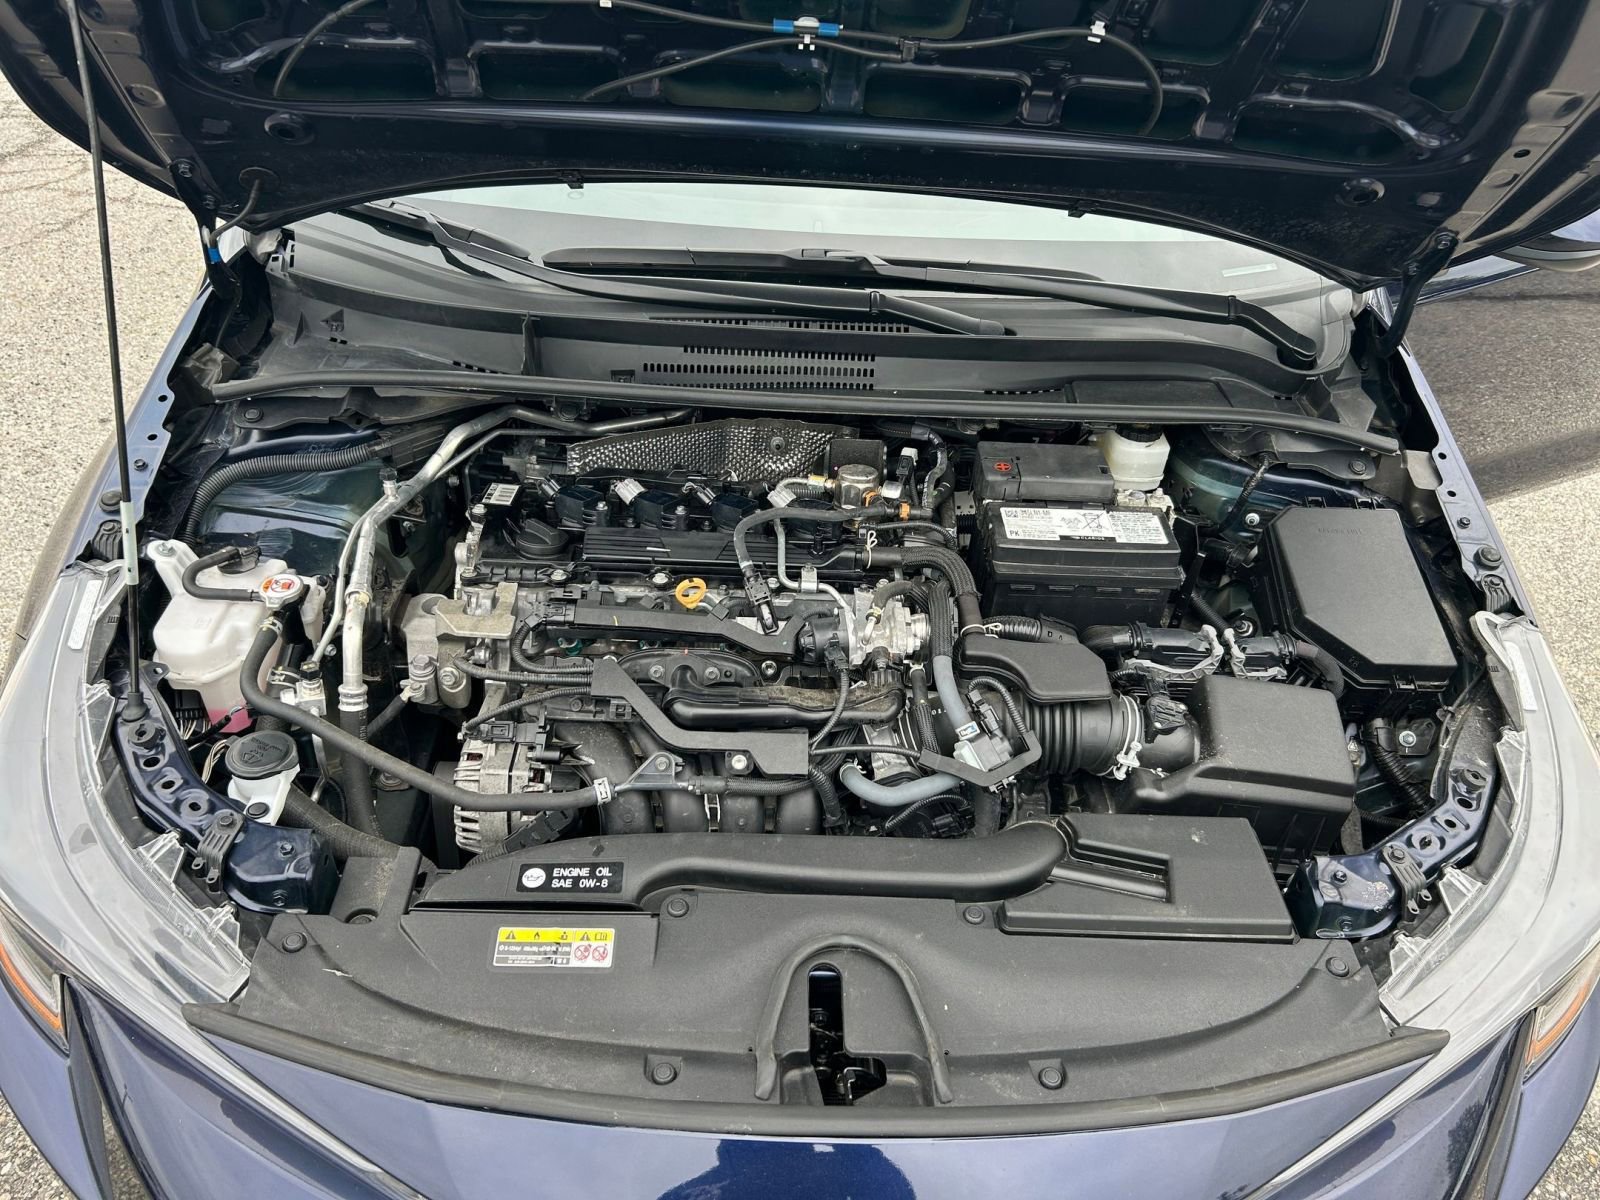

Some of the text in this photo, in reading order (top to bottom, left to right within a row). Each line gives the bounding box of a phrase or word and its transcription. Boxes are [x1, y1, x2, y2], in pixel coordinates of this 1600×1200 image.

[552, 867, 612, 877] ENGINE OIL
[551, 879, 608, 888] SAE 0W-8
